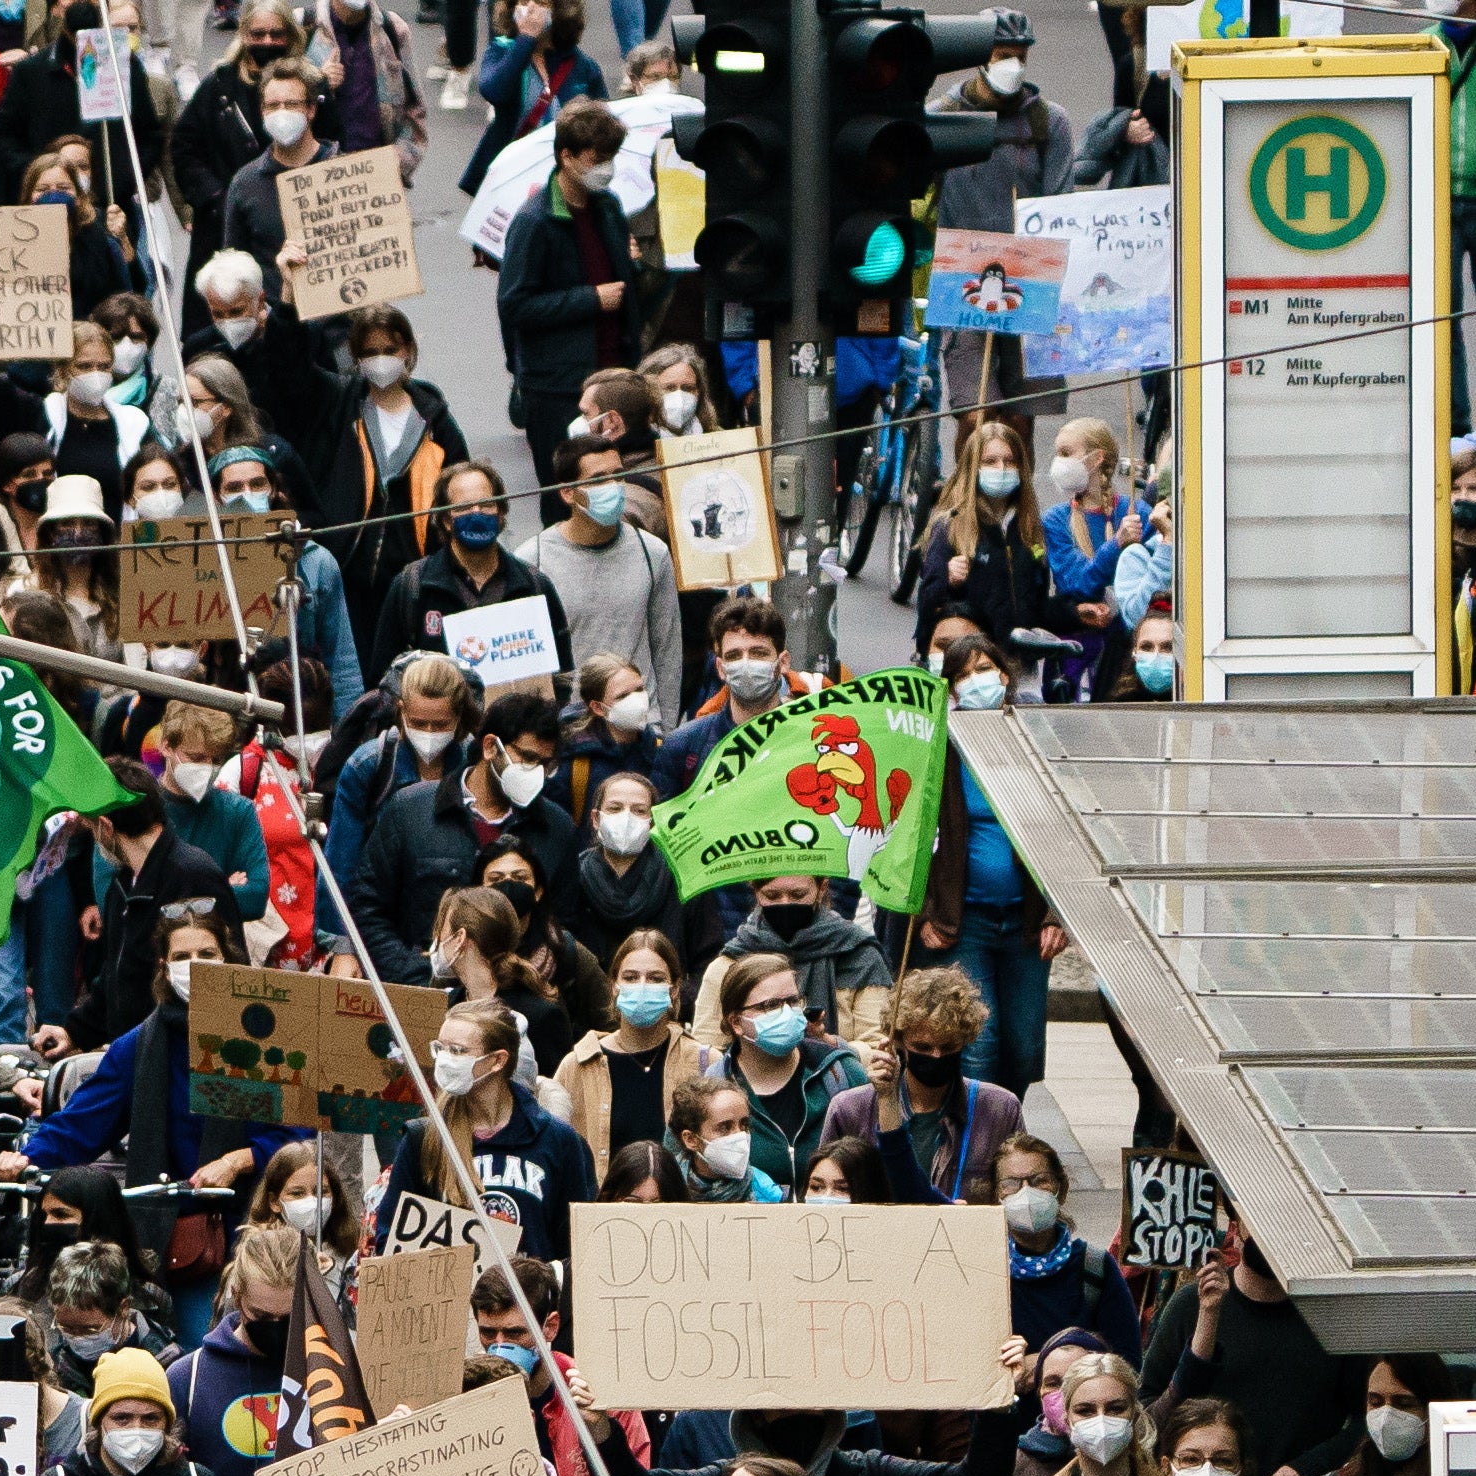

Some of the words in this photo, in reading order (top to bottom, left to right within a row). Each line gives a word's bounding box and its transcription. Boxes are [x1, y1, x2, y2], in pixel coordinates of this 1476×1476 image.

[317, 184, 367, 206] WATCH
[1286, 147, 1350, 220] H
[13, 274, 68, 296] OTHER
[16, 299, 66, 322] OUR
[1245, 300, 1269, 314] M1
[1287, 297, 1323, 309] Mitte
[1287, 311, 1309, 325] Am
[1312, 310, 1405, 328] Kupfergraben
[1245, 361, 1266, 376] 12
[1287, 358, 1323, 370] Mitte
[1287, 373, 1309, 386] Am
[1312, 372, 1406, 389] Kupfergraben
[137, 590, 274, 630] KLIMA
[2, 691, 46, 756] FOR
[596, 1213, 765, 1288] DON'T
[795, 1213, 875, 1284] BE
[913, 1216, 971, 1286] A
[597, 1294, 791, 1383] FOSSIL
[804, 1299, 959, 1384] FOOL
[341, 1412, 447, 1465] HESITATING
